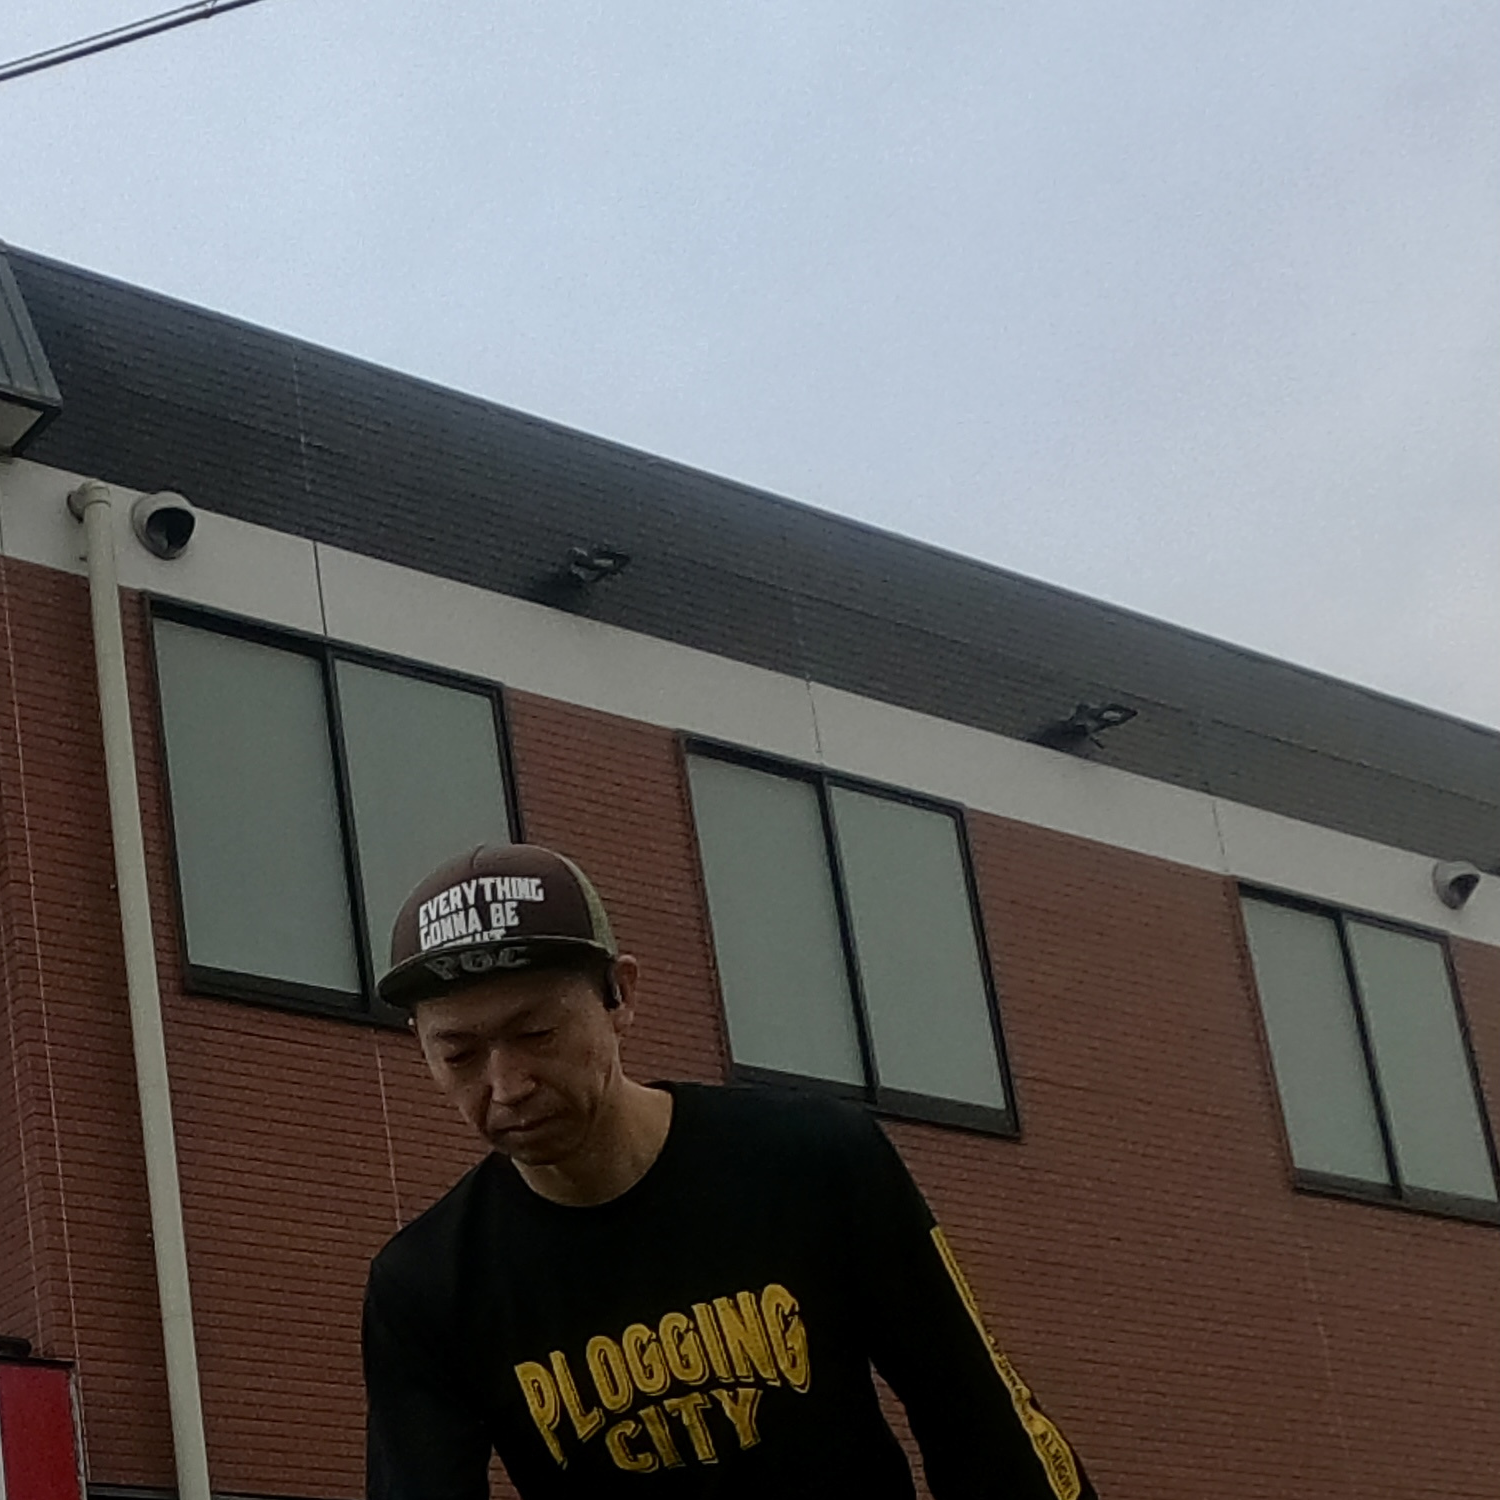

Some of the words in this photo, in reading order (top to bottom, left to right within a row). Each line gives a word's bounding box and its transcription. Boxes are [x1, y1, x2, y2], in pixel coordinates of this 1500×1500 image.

[420, 906, 483, 951] GONNA
[490, 900, 520, 928] BE
[514, 1283, 811, 1471] PLOGGING
[605, 1387, 764, 1474] CITY
